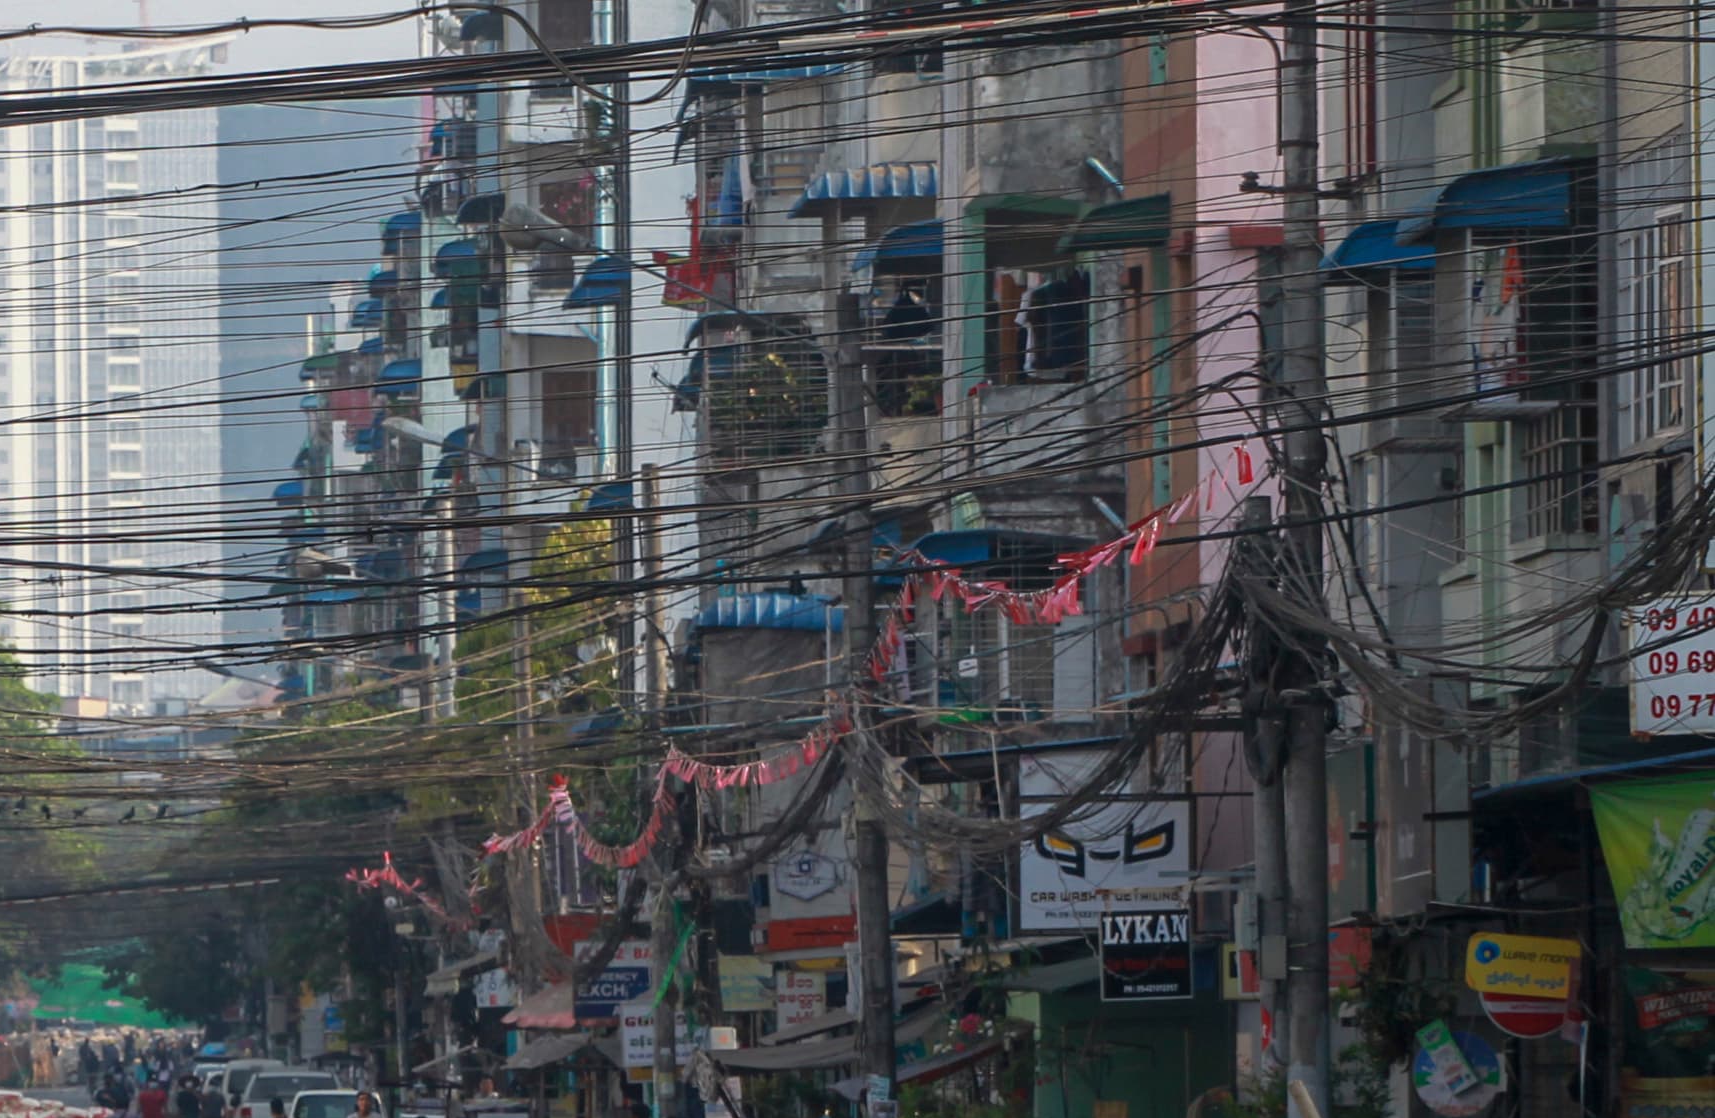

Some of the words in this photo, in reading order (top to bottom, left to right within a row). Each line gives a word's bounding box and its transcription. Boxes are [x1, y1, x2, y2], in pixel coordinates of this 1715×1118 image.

[1648, 608, 1677, 631] 09
[1649, 651, 1678, 675] 09
[1651, 695, 1681, 719] 09
[1031, 892, 1056, 904] CAR
[1060, 891, 1097, 903] WASH
[1103, 914, 1188, 945] LYKAN
